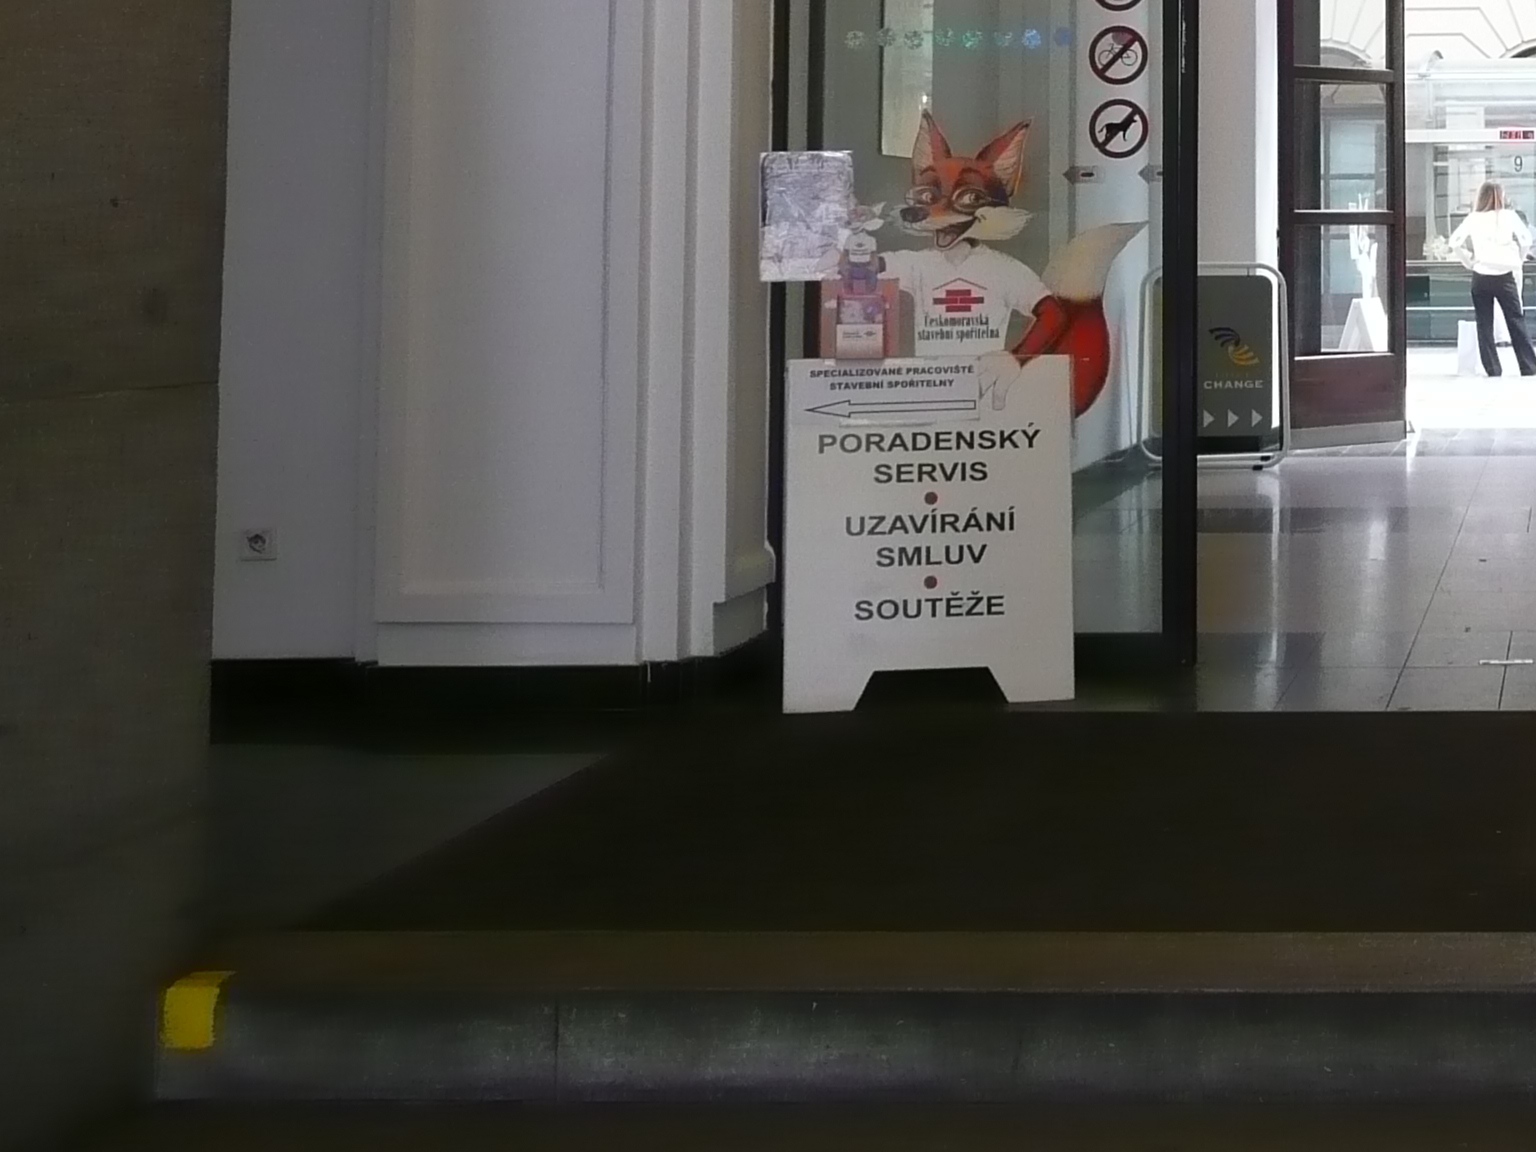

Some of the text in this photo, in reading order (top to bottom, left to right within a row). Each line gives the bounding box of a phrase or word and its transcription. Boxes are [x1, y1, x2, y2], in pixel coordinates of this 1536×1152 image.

[1514, 155, 1523, 173] 9
[809, 364, 975, 378] SPECIALIZOVANÉ PRACOVIŠTĚ
[830, 378, 955, 391] STAVEBNÍ SPOŘITELNY
[1203, 379, 1264, 390] CHANGE
[818, 422, 1041, 454] PORADENSKÝ
[873, 461, 989, 484] SERVIS
[845, 506, 1015, 537] UZAVÍRÁNÍ
[876, 543, 988, 568] SMLUV
[854, 590, 1005, 621] SOUTĚŽE
